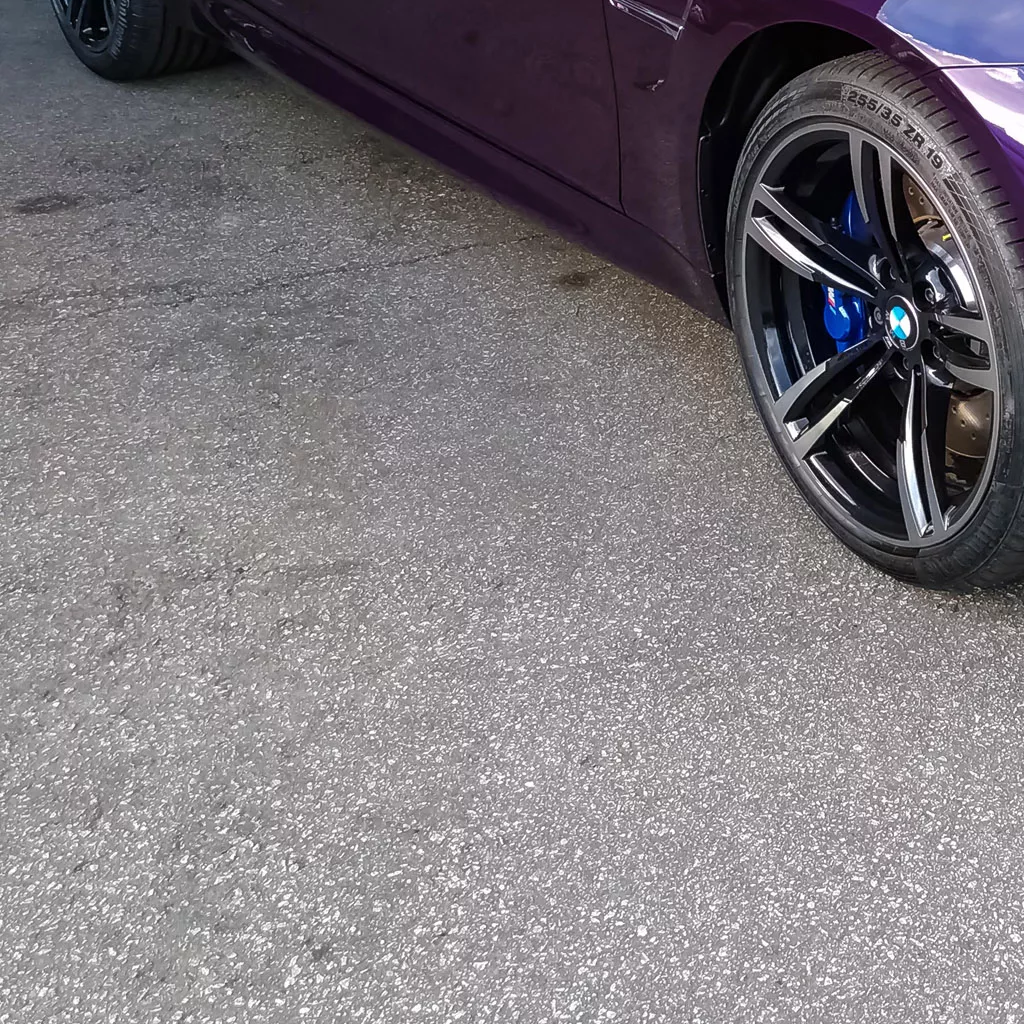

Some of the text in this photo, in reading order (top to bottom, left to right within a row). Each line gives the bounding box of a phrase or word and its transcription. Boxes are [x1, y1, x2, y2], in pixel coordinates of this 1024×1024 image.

[847, 90, 944, 170] 255/35 ZR 19
